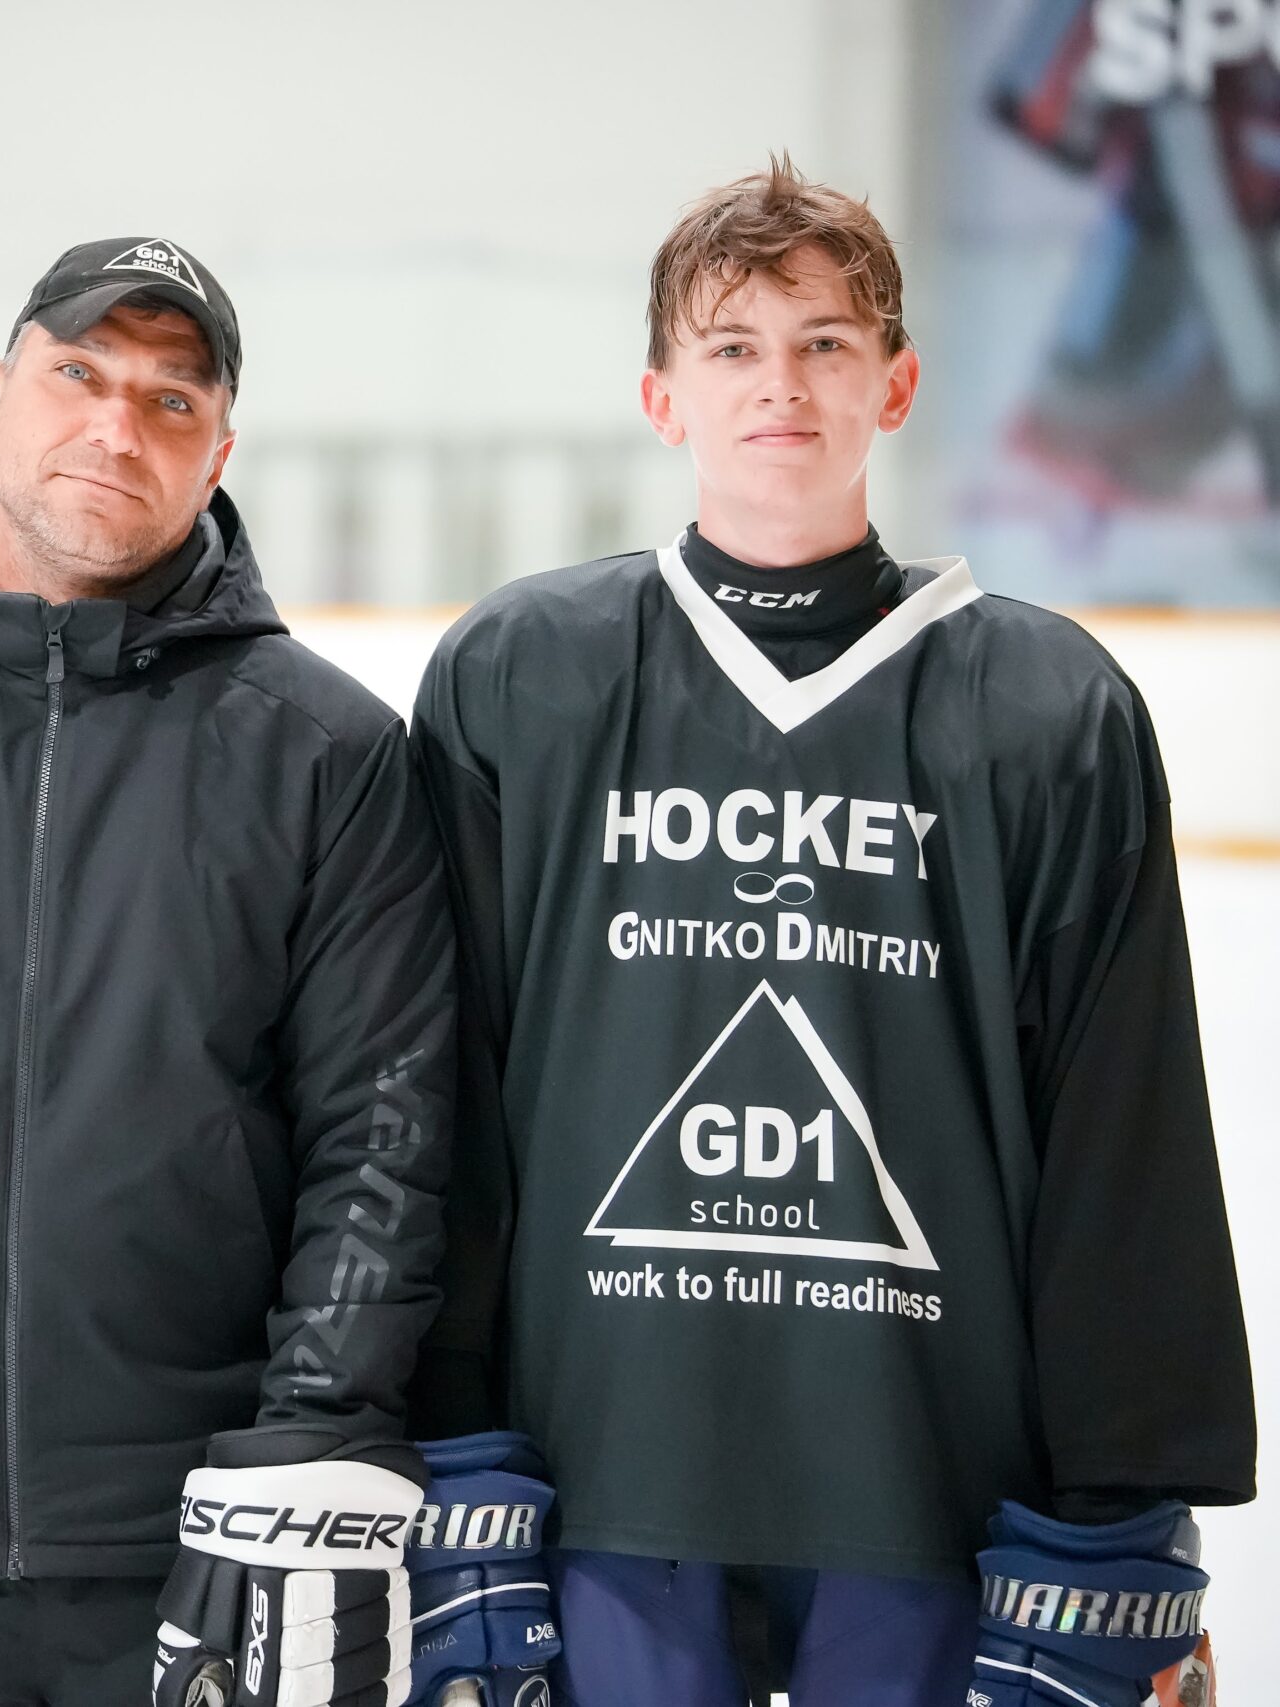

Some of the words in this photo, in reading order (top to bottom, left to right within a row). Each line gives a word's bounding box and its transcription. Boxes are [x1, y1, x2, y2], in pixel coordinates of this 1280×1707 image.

[1087, 0, 1280, 100] SP
[132, 259, 180, 277] school
[136, 247, 180, 268] GD1
[713, 583, 822, 609] CCM
[603, 787, 938, 880] HOCKEY
[607, 911, 766, 961] GNITKO
[776, 912, 940, 979] DMITRIY
[675, 1099, 835, 1182] GD1
[690, 1194, 820, 1231] school
[588, 1263, 665, 1299] work
[676, 1265, 713, 1301] to
[723, 1266, 782, 1305] full
[795, 1277, 942, 1321] readiness
[181, 1494, 408, 1551] ISCHER
[982, 1574, 1207, 1638] WARRIOR
